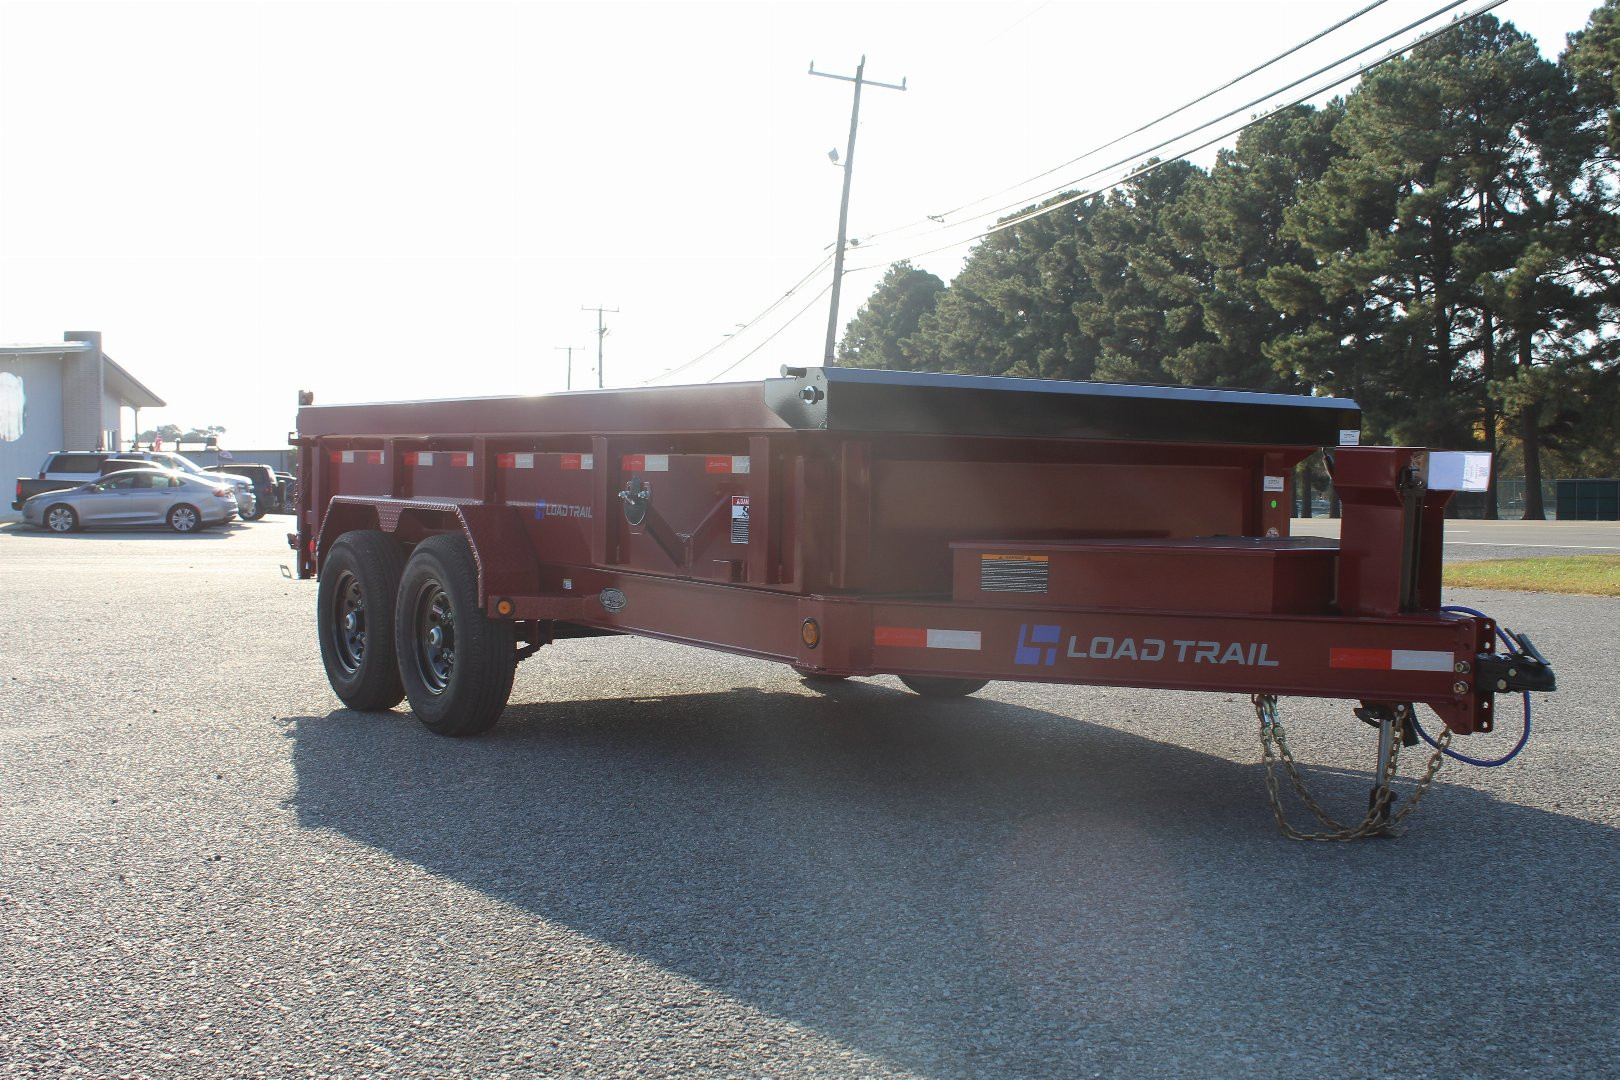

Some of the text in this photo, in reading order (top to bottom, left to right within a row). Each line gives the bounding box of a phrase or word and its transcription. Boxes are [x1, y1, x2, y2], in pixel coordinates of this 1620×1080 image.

[545, 504, 592, 518] LOAD TRAIL
[1066, 635, 1280, 667] LOAD TRAIL
